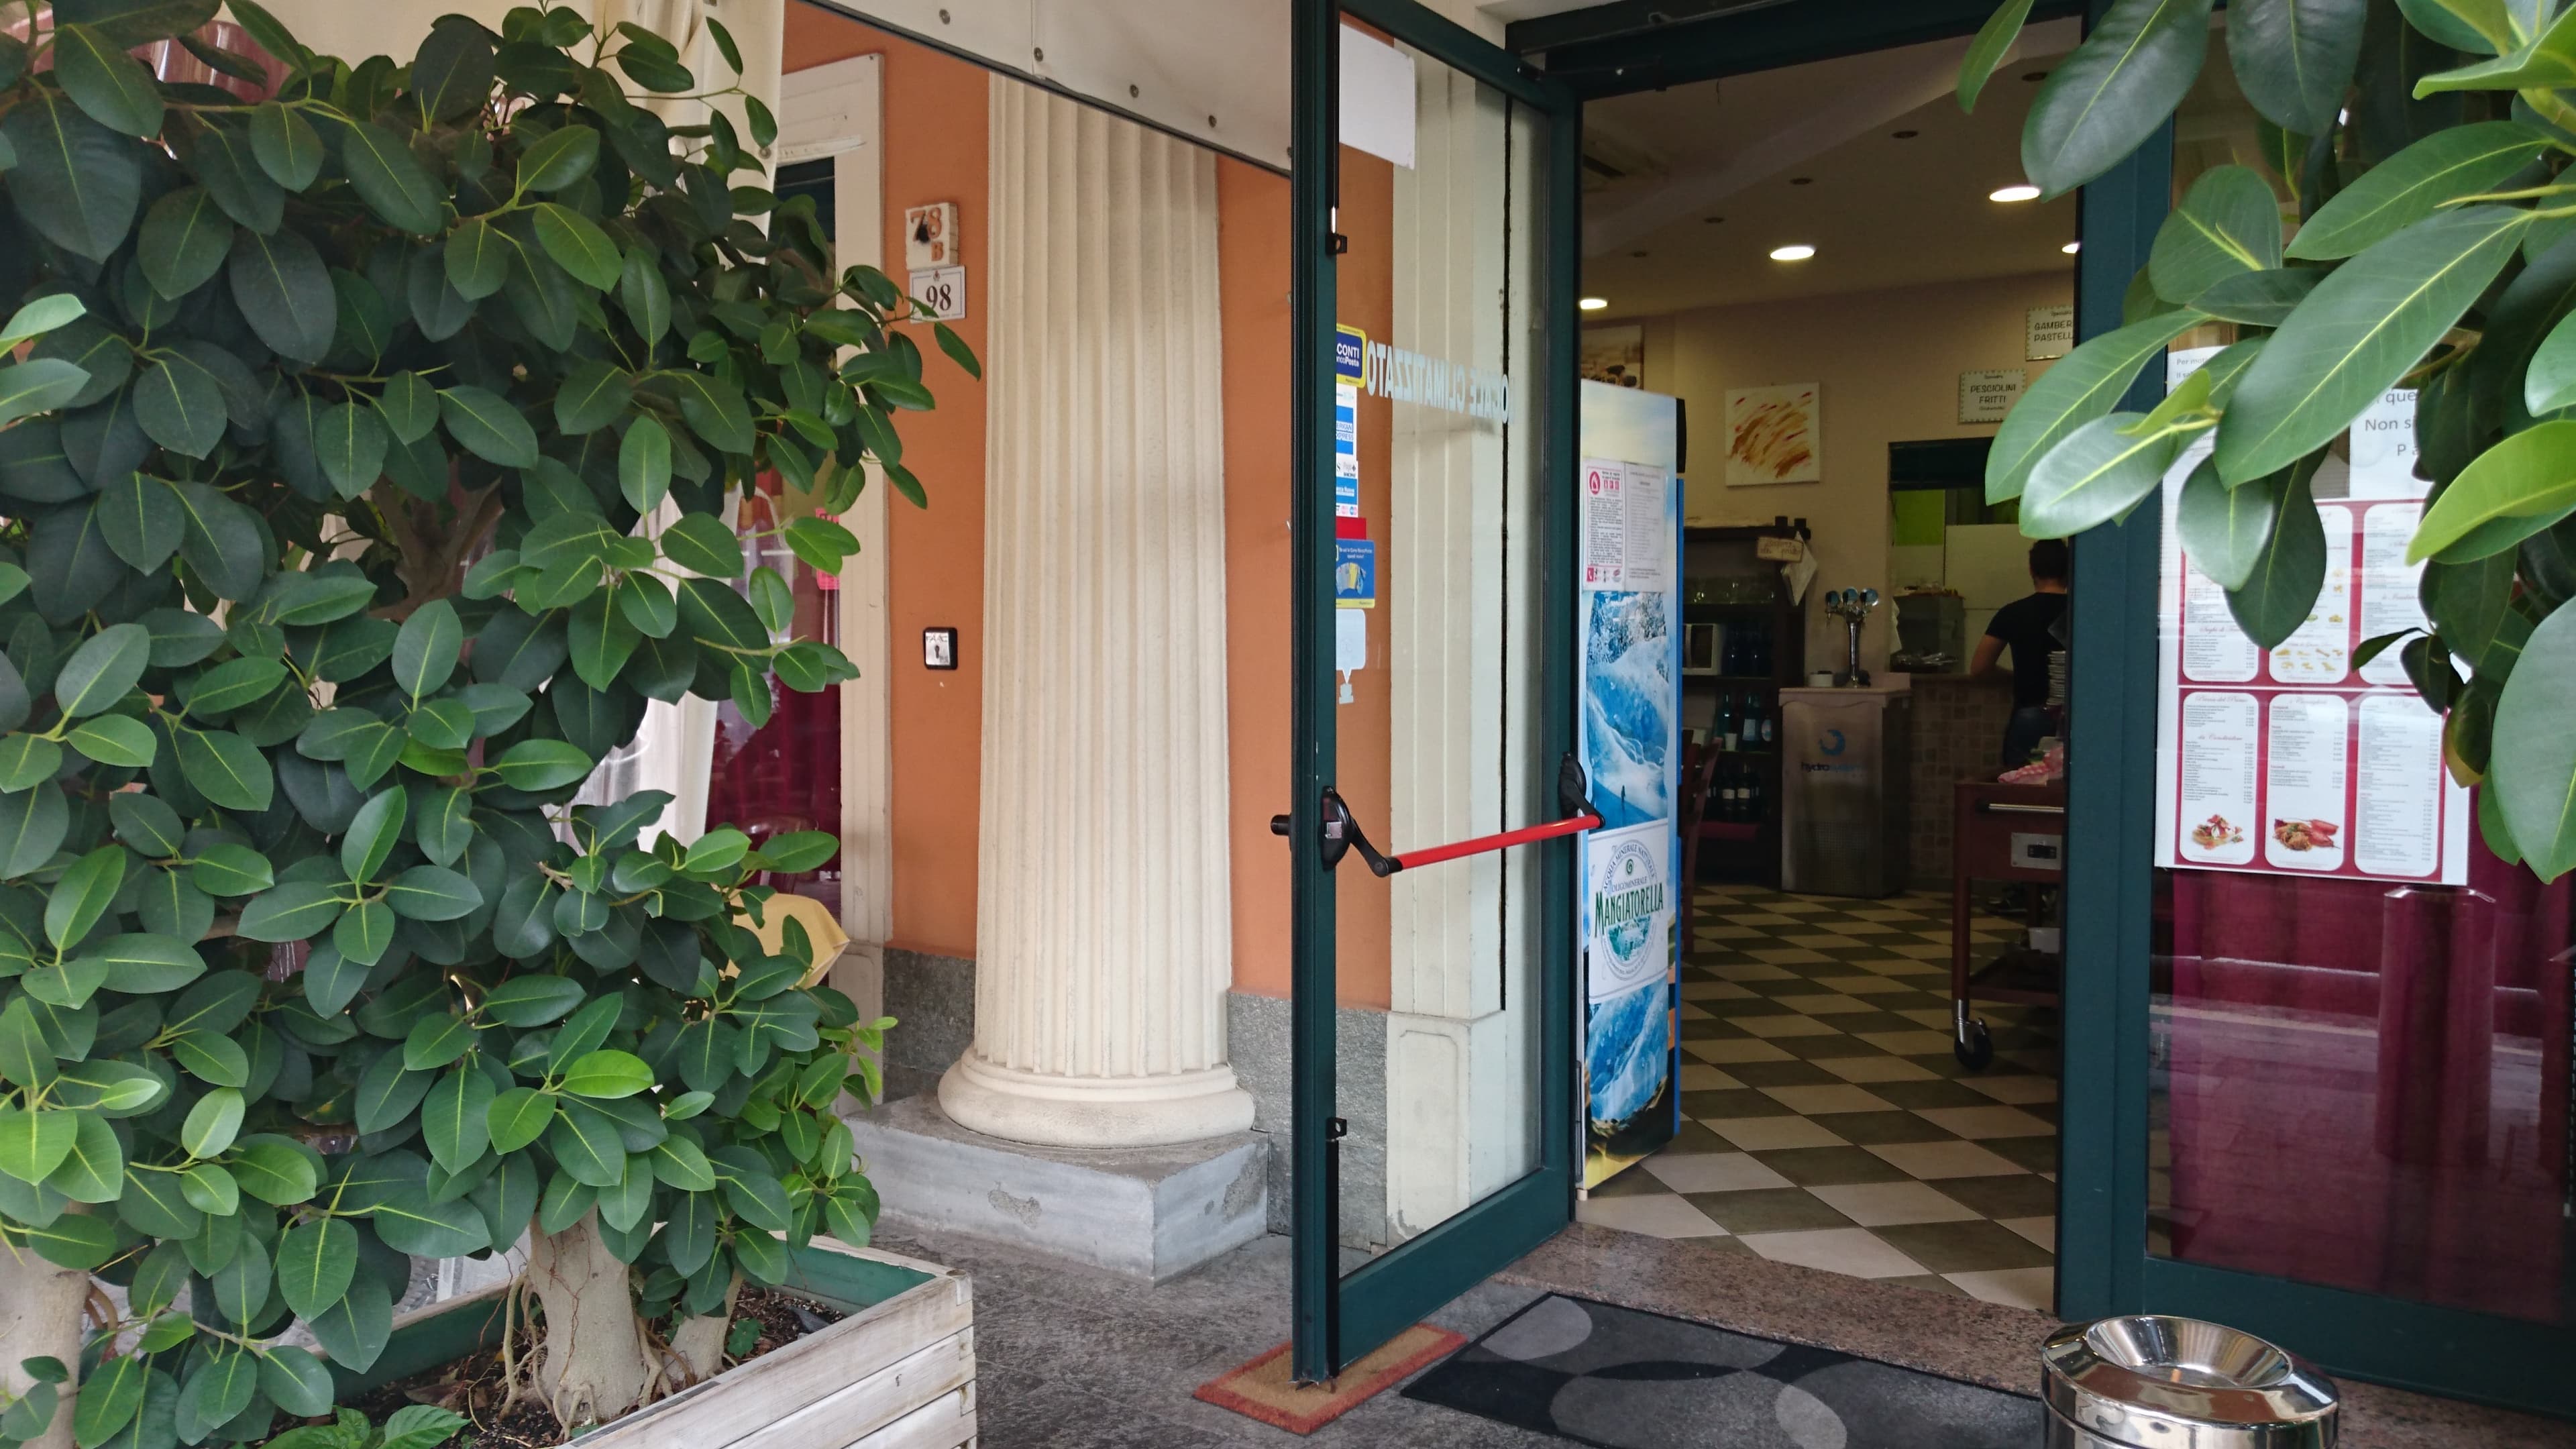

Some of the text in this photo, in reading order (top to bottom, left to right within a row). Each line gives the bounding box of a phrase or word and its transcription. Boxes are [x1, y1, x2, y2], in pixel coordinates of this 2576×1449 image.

[926, 284, 951, 311] 98
[2034, 320, 2072, 331] GAMBER
[2034, 332, 2073, 342] PASTELL
[1336, 343, 1360, 359] CONTI
[1336, 355, 1360, 368] ncoPosta
[1970, 384, 2017, 394] PESCIOLINI
[1979, 395, 2006, 404] FRITTI
[2385, 391, 2416, 405] que
[1336, 422, 1352, 431] ERICAN
[2365, 419, 2412, 431] Non s
[1603, 861, 1616, 892] ACQUA
[1615, 843, 1638, 860] MINERALE
[1611, 875, 1648, 892] OLIGOMINERALE
[1595, 882, 1664, 938] MANGIATORELLA
